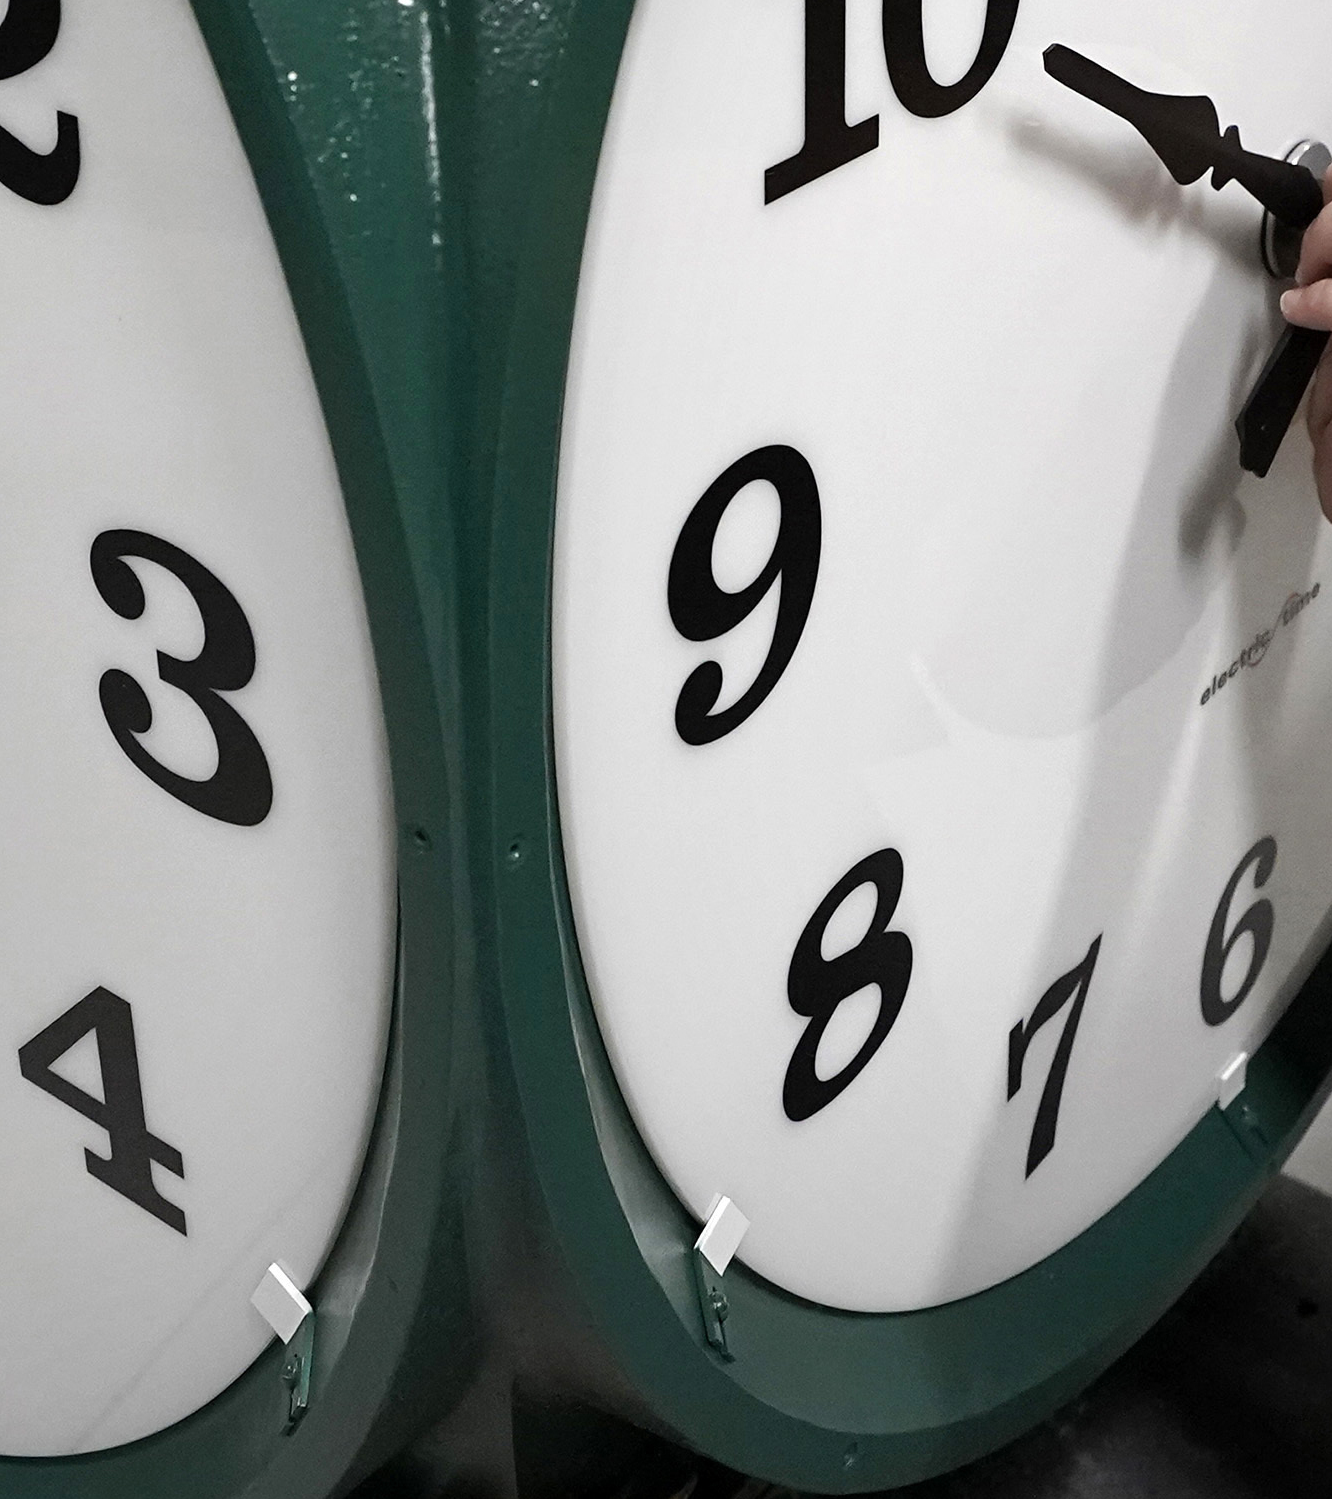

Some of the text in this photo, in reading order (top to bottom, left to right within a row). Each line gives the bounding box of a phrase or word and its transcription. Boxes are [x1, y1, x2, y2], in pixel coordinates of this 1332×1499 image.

[90, 529, 273, 826] 3
[667, 445, 821, 746] 9
[1200, 629, 1270, 706] electric
[783, 848, 913, 1122] 8
[1200, 835, 1277, 1026] 6
[18, 986, 187, 1236] 4
[1007, 934, 1102, 1180] 7
